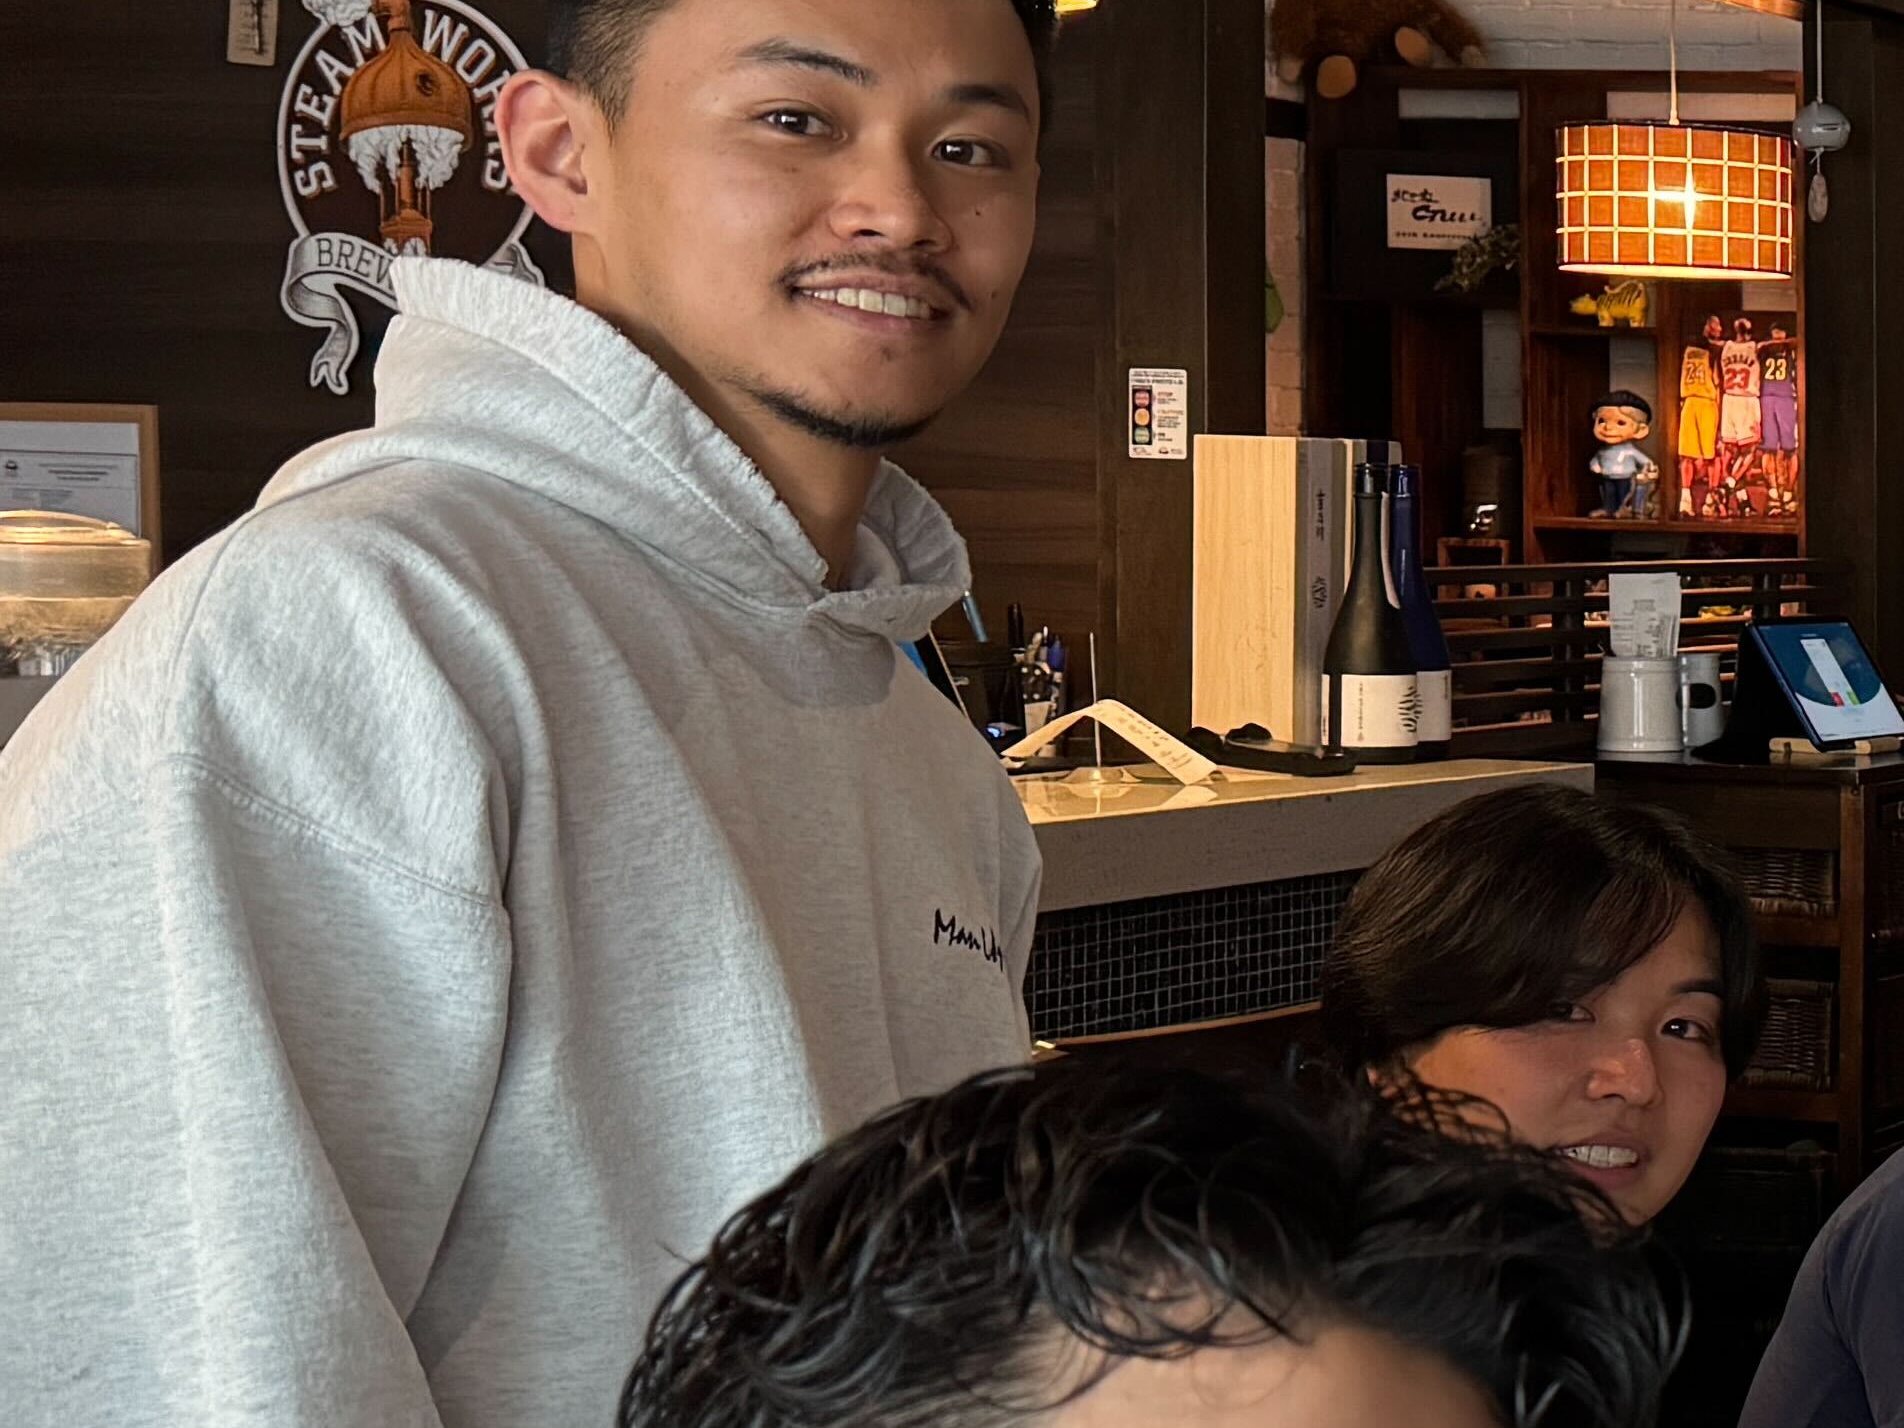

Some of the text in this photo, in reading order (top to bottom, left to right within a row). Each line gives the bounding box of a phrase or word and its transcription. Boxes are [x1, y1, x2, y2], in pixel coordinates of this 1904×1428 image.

[290, 13, 386, 196] STEAM
[1725, 368, 1750, 390] 23
[1764, 358, 1787, 380] 23
